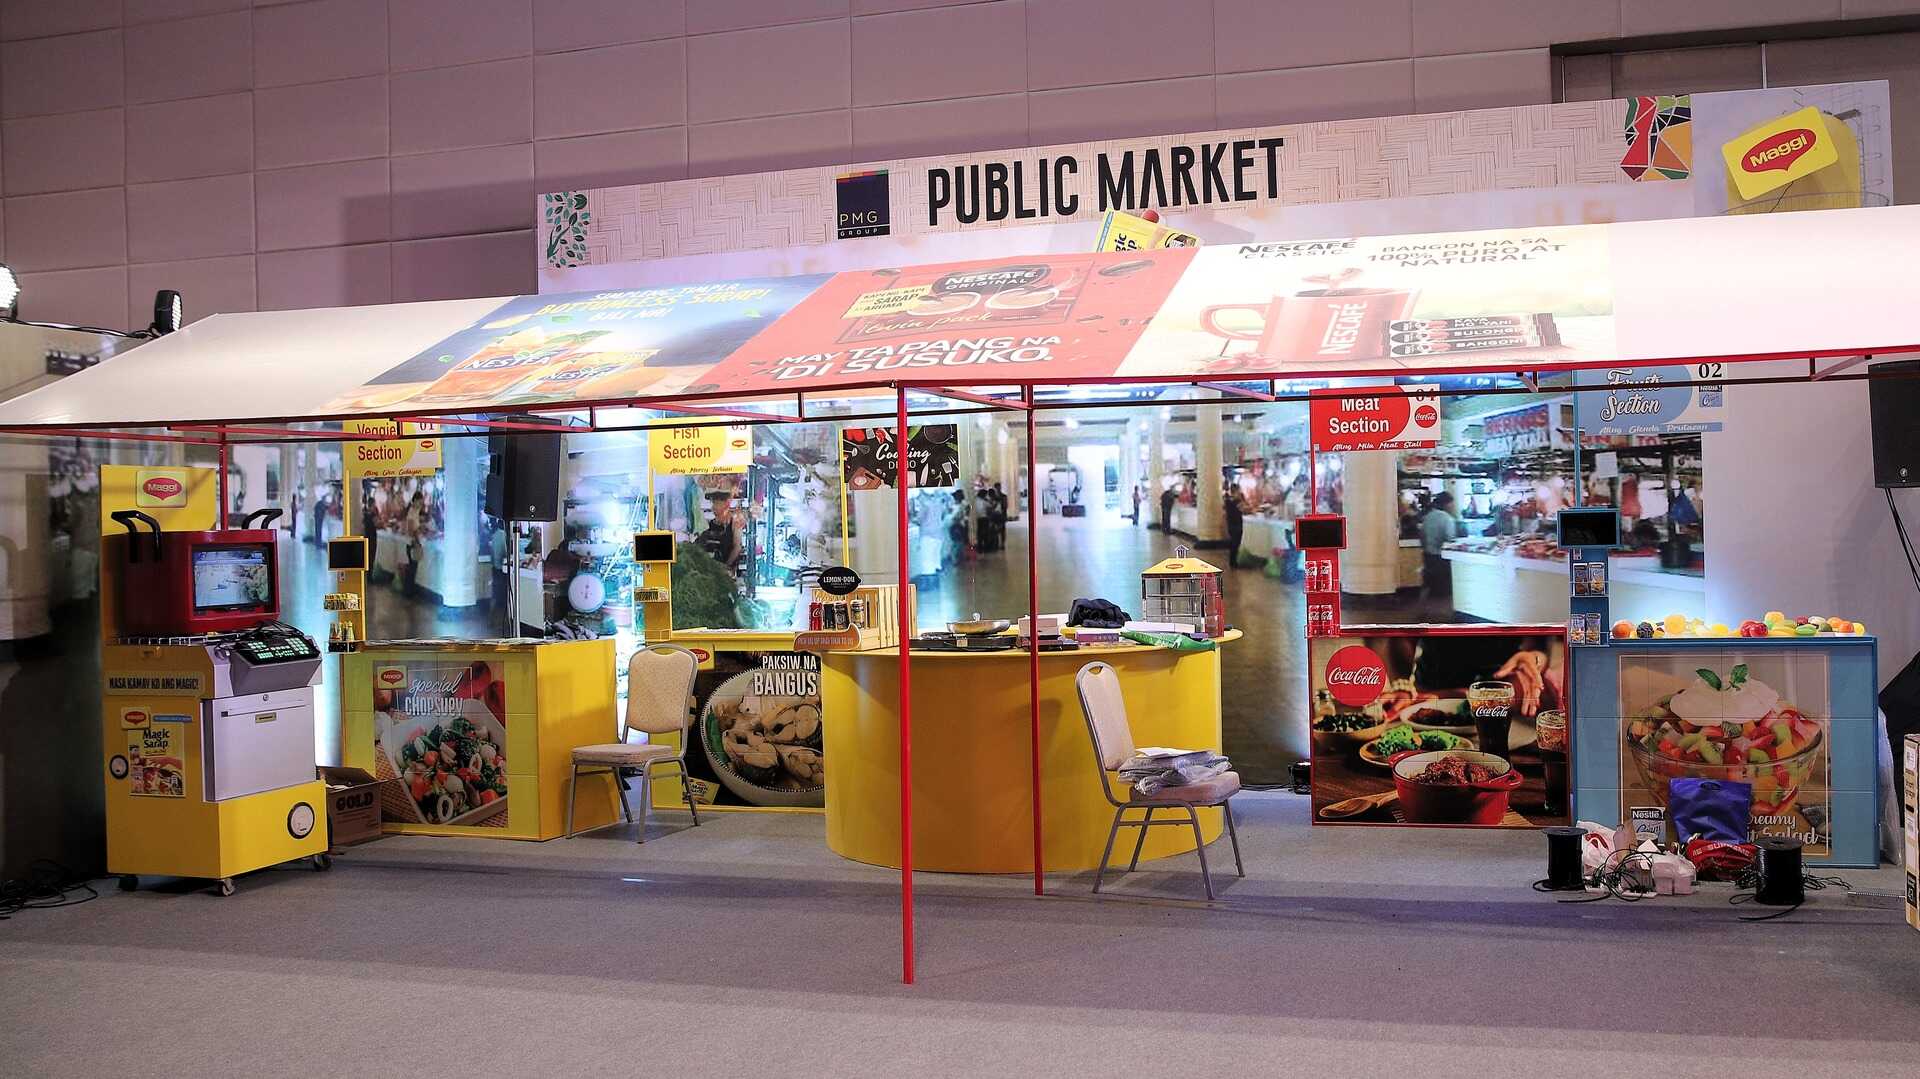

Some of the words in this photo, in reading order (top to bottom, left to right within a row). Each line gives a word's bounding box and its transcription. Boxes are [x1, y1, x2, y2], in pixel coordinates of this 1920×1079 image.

[1750, 133, 1808, 168] Maggi
[928, 155, 1079, 226] PUBLIC
[1097, 138, 1284, 212] MARKET
[840, 210, 878, 226] PMG
[840, 227, 879, 237] GROUP
[1368, 252, 1433, 262] 100%
[1443, 247, 1520, 258] PURO
[1531, 244, 1567, 252] AT
[1382, 242, 1474, 252] BANGON
[1483, 239, 1513, 247] NA
[1244, 249, 1344, 259] CLASSIC
[1401, 253, 1537, 267] NATURAL
[945, 278, 1028, 290] ORIGINAL
[779, 352, 844, 365] MAY
[850, 337, 1017, 361] TAPANG
[1021, 336, 1062, 346] NA
[1699, 363, 1722, 378] 02
[1341, 396, 1380, 411] Meat
[1600, 393, 1661, 422] Section
[673, 427, 700, 439] Fish
[1329, 417, 1390, 434] Section
[1600, 425, 1622, 434] Aling
[358, 445, 402, 460] Section
[664, 444, 711, 459] Section
[876, 443, 931, 463] Cooing
[1332, 443, 1352, 451] Aling
[1404, 440, 1422, 448] Stall
[888, 461, 917, 470] DO
[147, 483, 178, 494] Maggi
[762, 655, 800, 670] PAKSIW
[803, 655, 817, 670] NA
[409, 672, 463, 697] special
[754, 671, 817, 696] BANGUS
[405, 696, 464, 716] CHOPSUEY
[143, 728, 170, 742] Magic
[144, 740, 168, 749] Sarap
[1748, 815, 1796, 830] reamy
